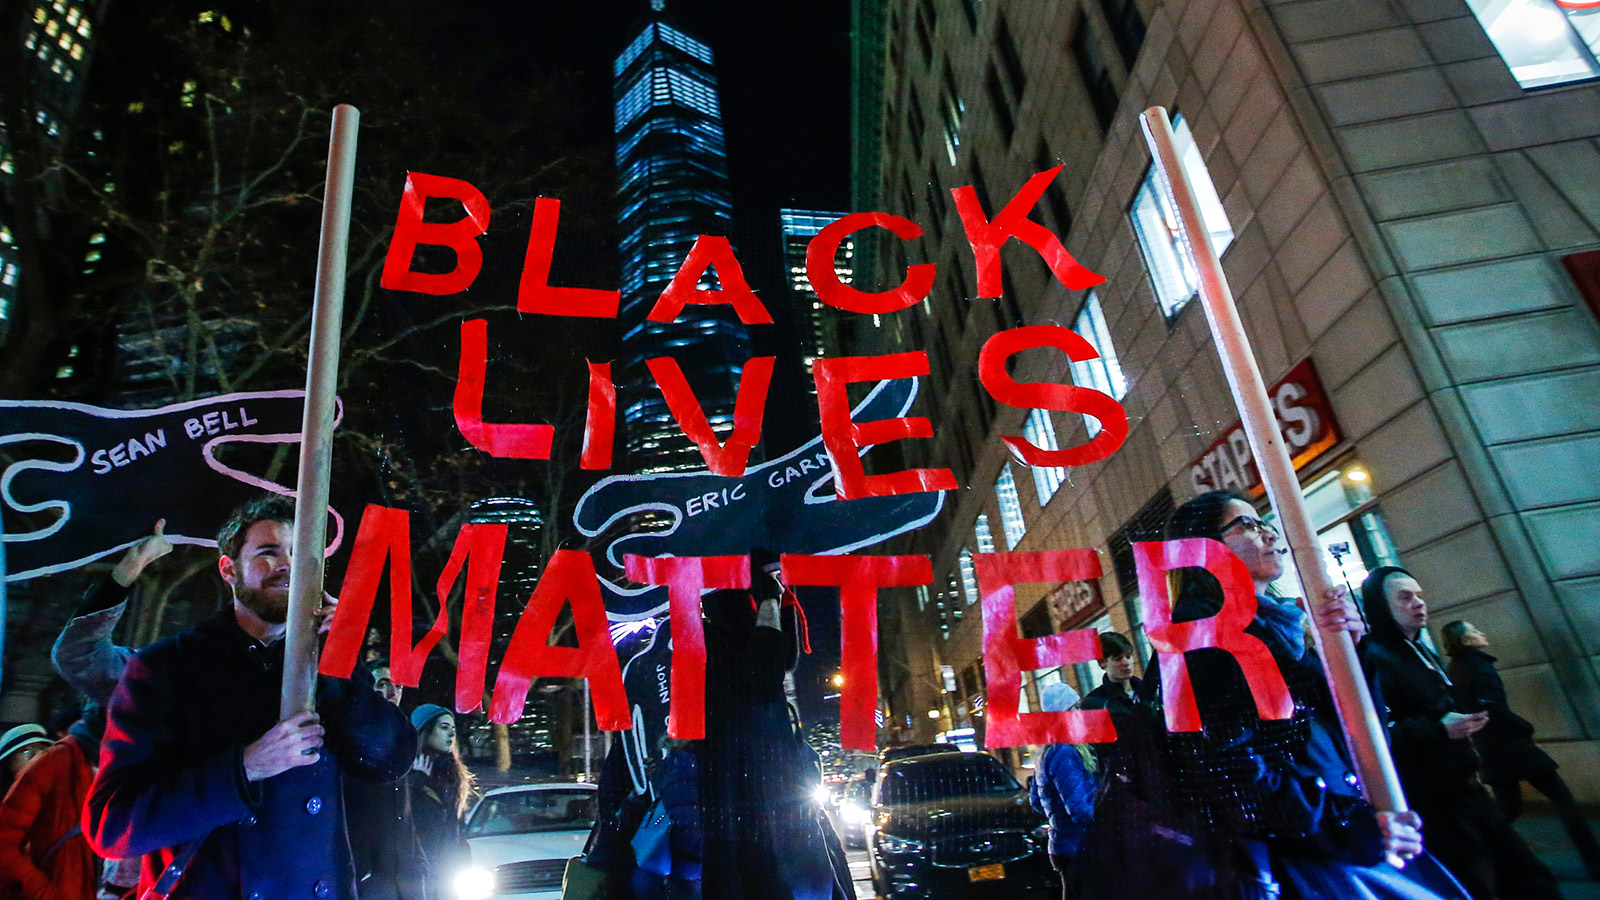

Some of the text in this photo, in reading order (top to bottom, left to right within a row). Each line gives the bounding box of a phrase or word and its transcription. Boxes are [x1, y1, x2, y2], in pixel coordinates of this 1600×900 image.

[381, 164, 1106, 325] BLACK
[90, 406, 259, 476] SEAN BELL
[453, 319, 1129, 500] LIVES
[1191, 382, 1320, 495] STAPS
[685, 482, 747, 518] ERIC
[319, 504, 1292, 751] MATTER
[656, 664, 670, 704] JOHN
